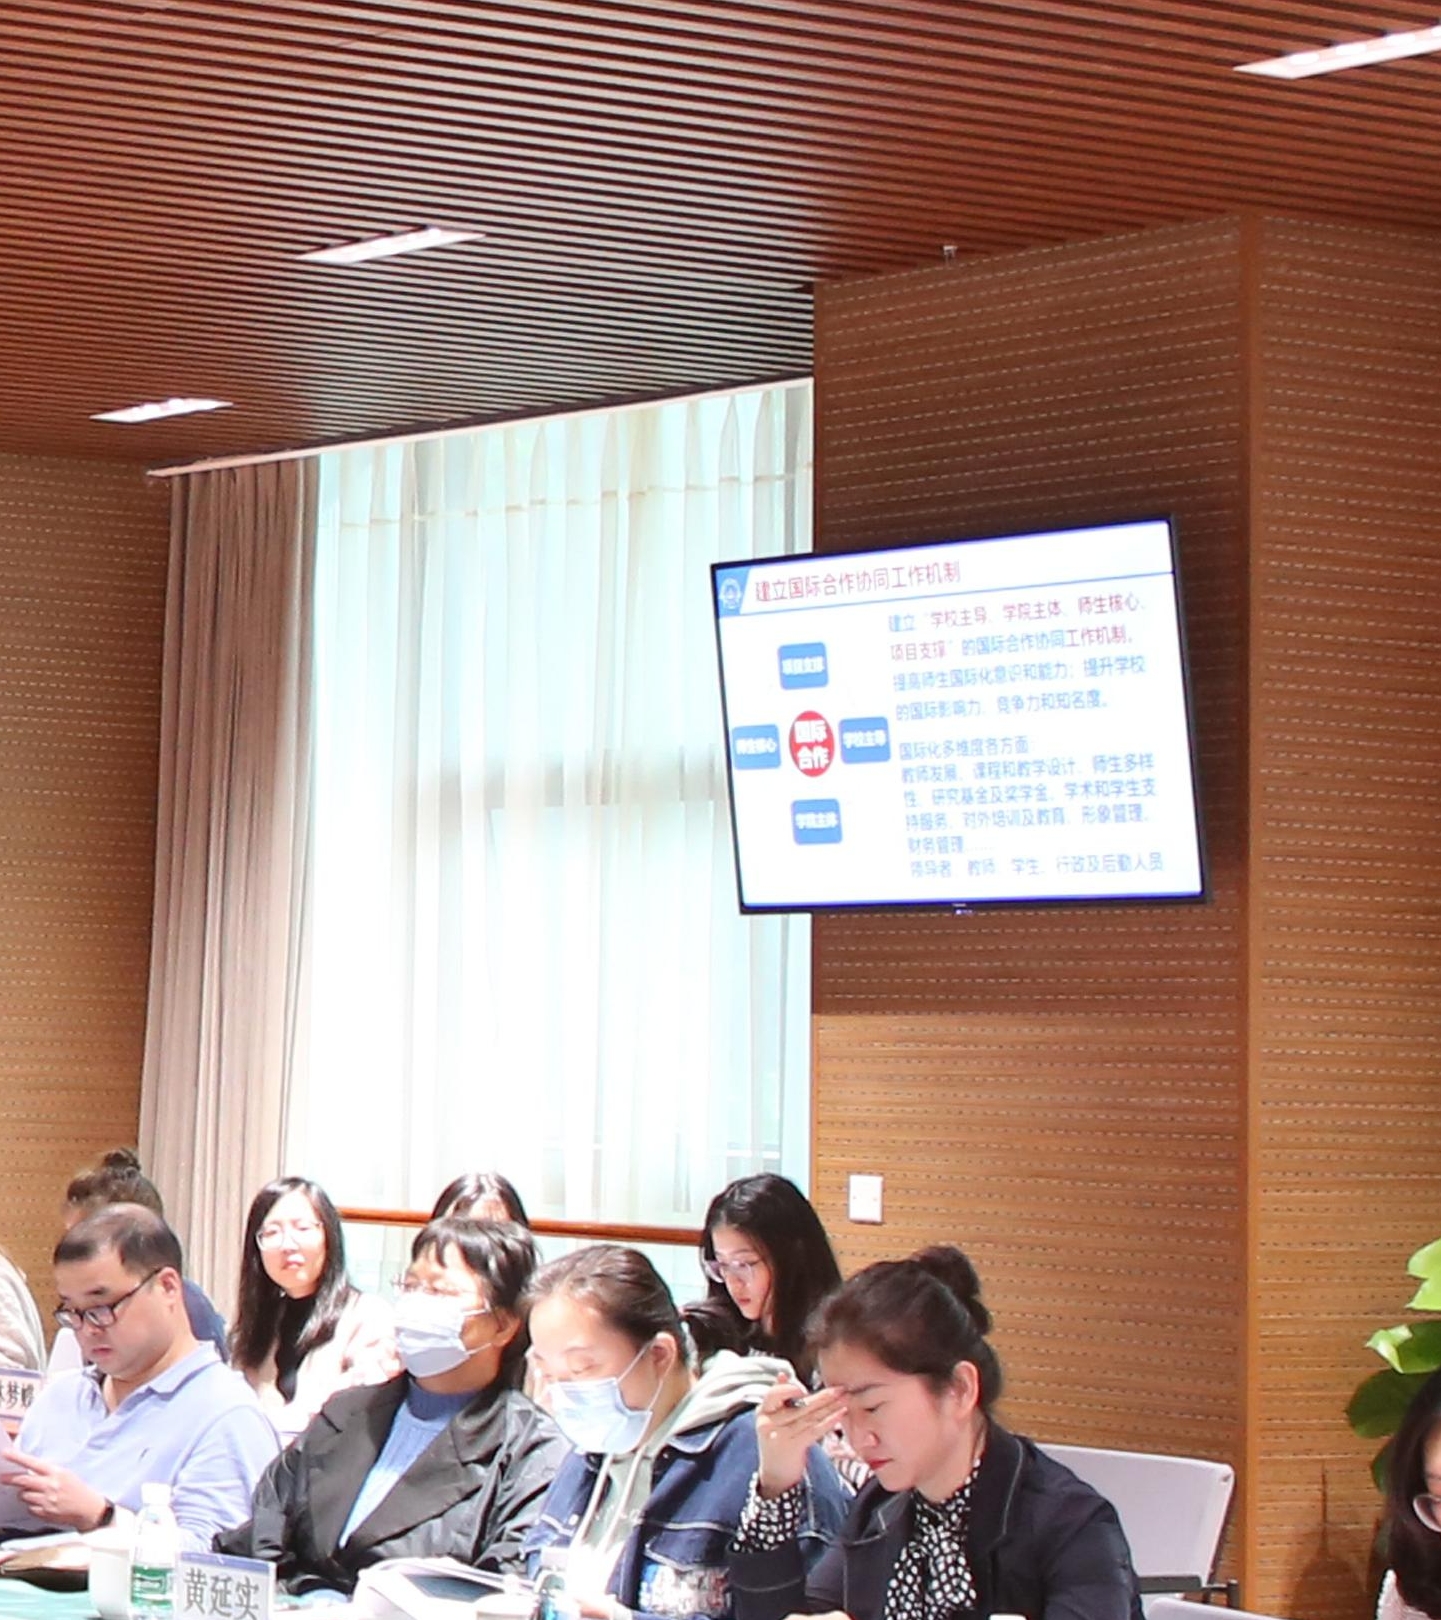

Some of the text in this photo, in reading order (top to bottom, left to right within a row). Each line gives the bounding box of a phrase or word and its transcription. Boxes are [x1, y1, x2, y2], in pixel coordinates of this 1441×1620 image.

[755, 561, 961, 602] 建立国际合作协同工作机制
